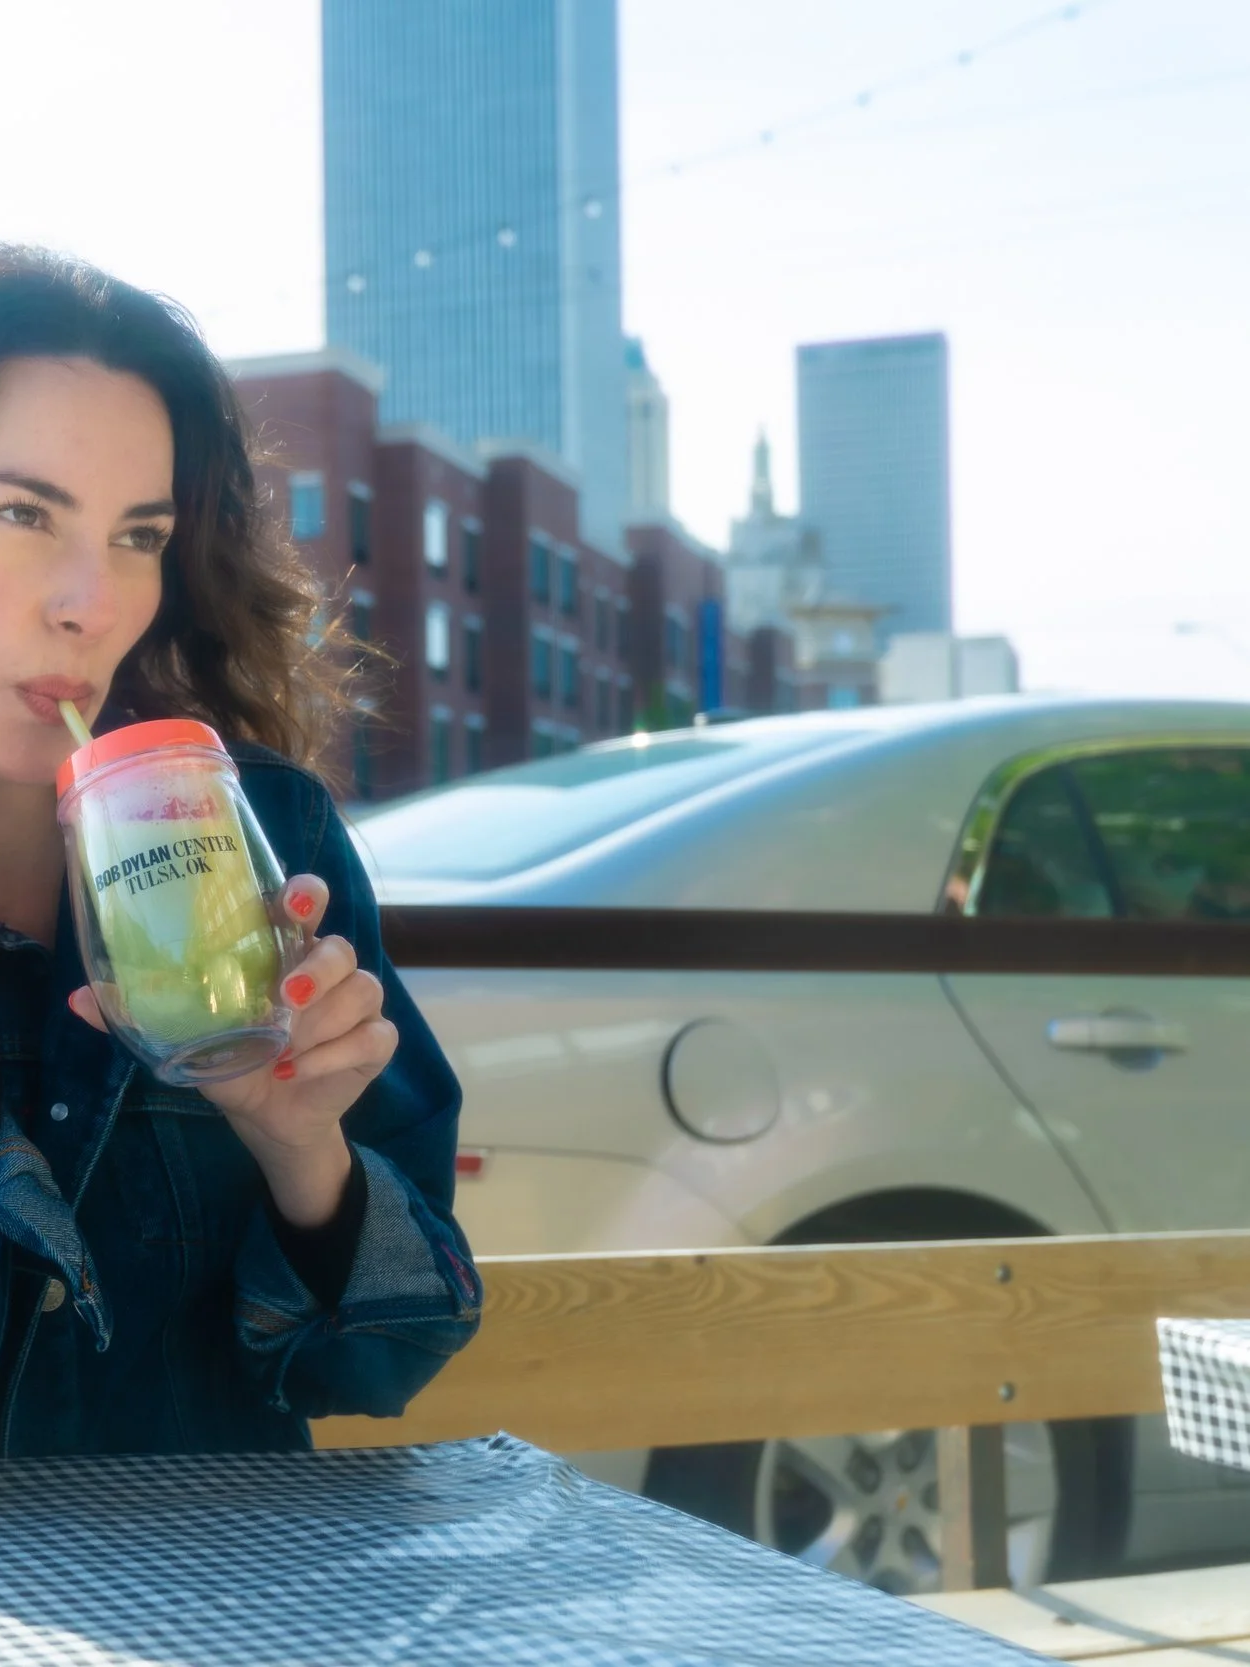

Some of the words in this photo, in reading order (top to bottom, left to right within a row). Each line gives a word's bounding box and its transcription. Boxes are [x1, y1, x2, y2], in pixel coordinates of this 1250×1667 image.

[95, 864, 121, 892] BOB
[121, 845, 171, 877] DYLAN
[172, 835, 238, 858] CENTER
[125, 863, 186, 895] TULSA,
[186, 856, 213, 875] OK
